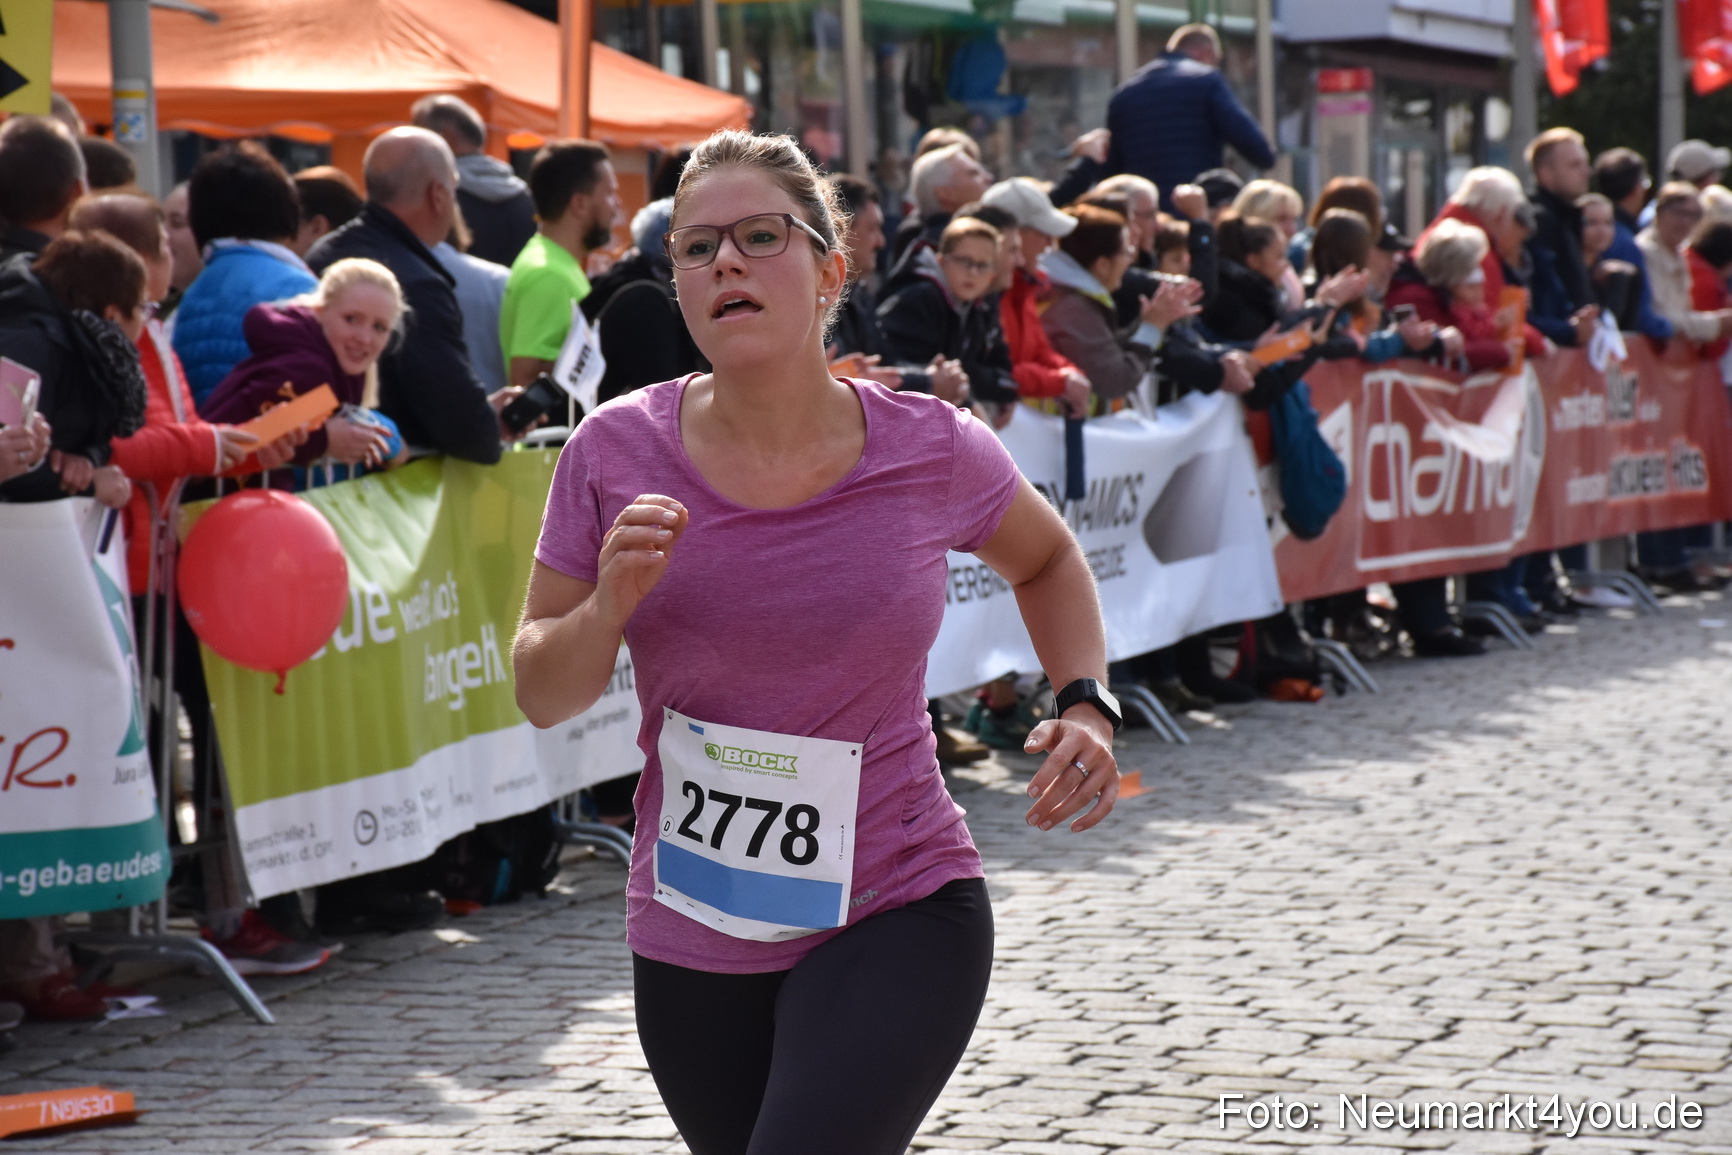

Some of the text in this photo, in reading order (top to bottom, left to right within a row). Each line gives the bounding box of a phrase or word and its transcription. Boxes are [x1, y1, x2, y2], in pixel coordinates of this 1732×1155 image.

[721, 764, 743, 772] inspired
[745, 766, 752, 774] by
[771, 772, 798, 780] concepts
[722, 746, 798, 773] BOCK
[677, 781, 820, 865] 2778
